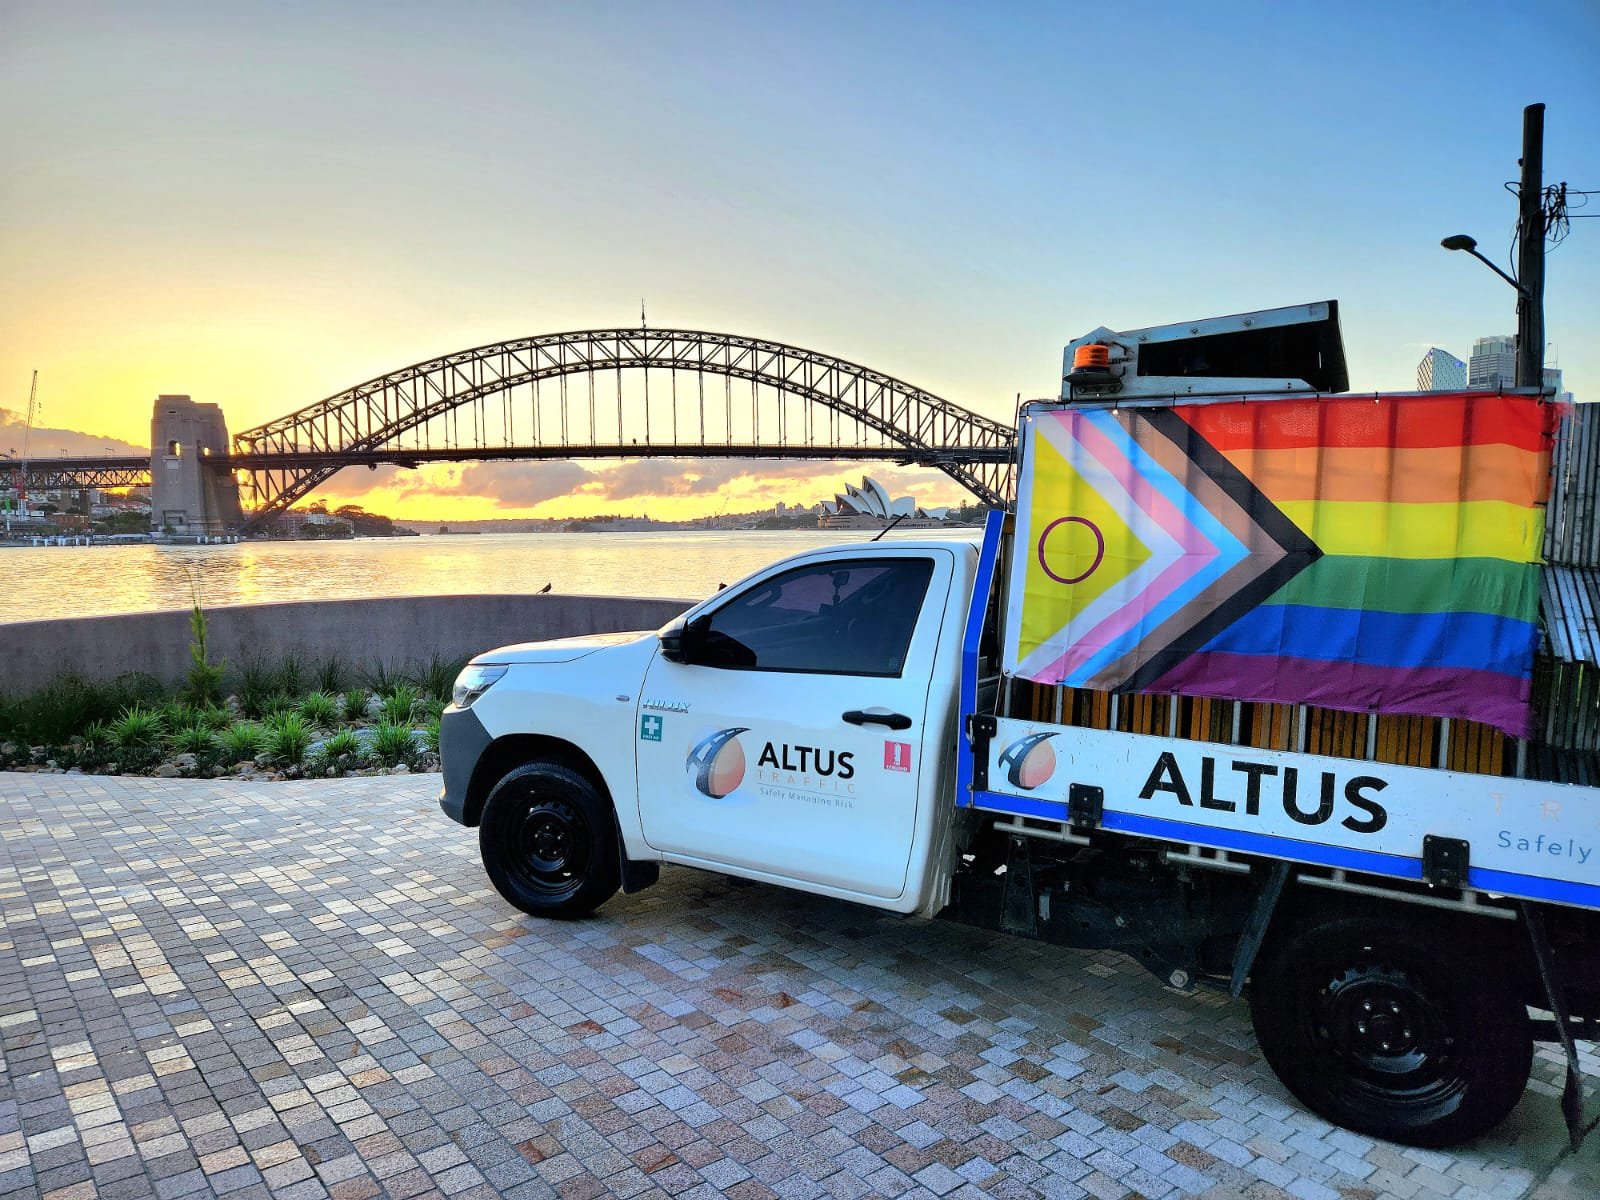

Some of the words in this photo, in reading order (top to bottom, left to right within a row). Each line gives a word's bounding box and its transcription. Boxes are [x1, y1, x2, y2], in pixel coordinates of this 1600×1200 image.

[757, 741, 855, 780] ALTUS
[757, 769, 855, 794] TRAFFIC
[1138, 750, 1390, 834] ALTUS
[1489, 791, 1600, 832] TR
[1498, 830, 1592, 864] Safely
